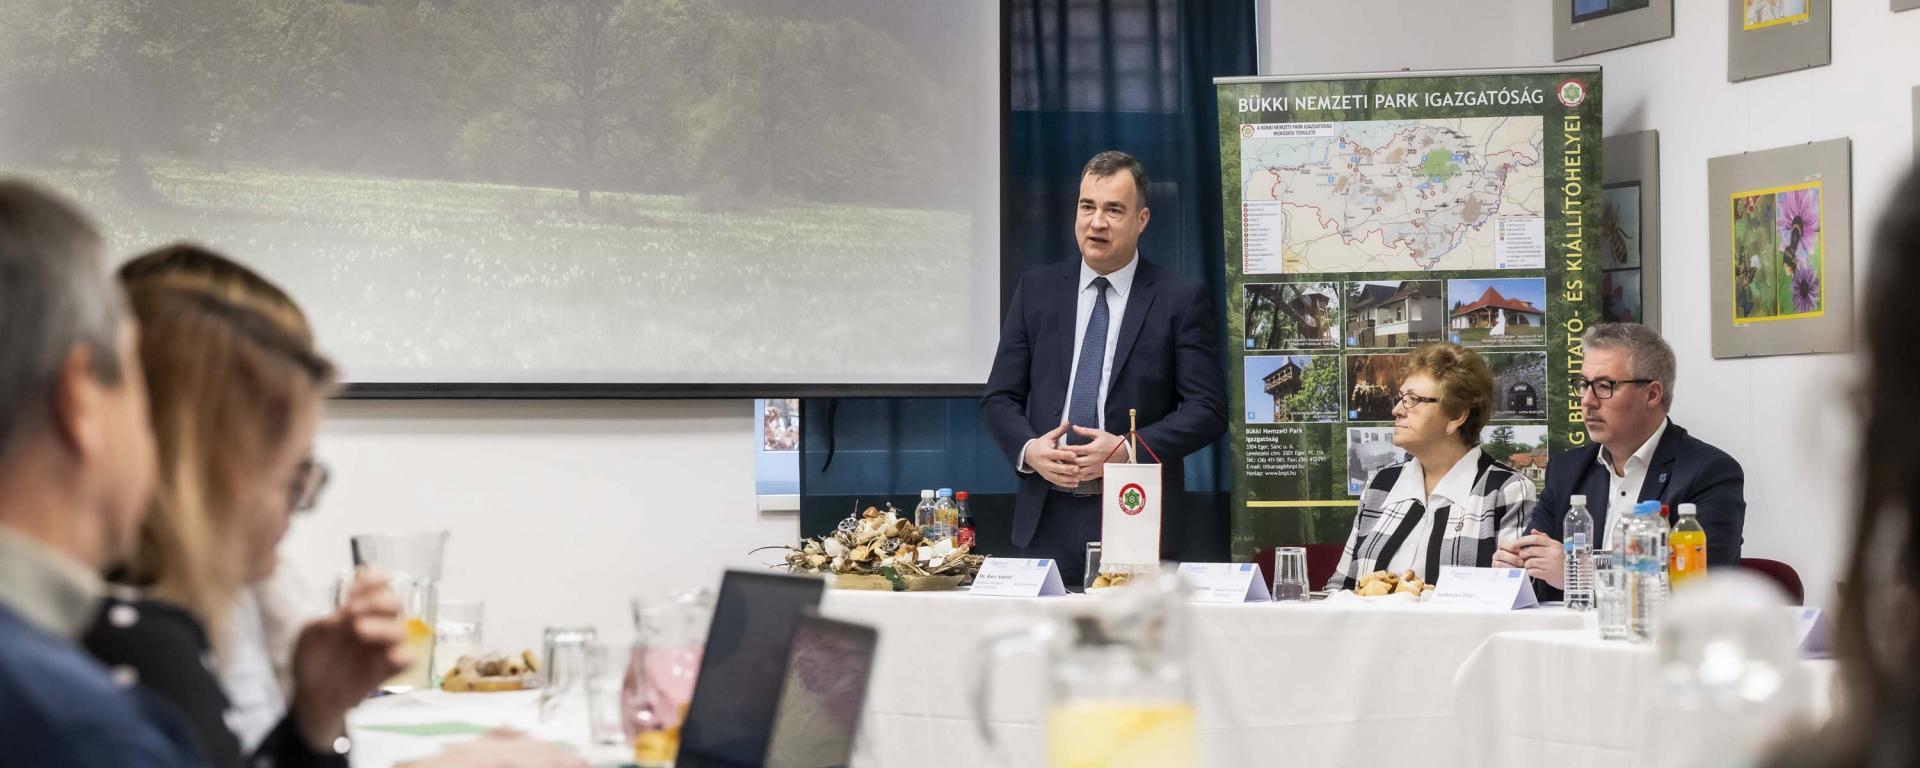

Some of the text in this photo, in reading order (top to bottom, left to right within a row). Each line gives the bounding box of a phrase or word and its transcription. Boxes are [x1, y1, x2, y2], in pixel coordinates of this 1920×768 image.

[1238, 95, 1288, 113] BÜKKI
[1295, 94, 1368, 111] NEMZETI
[1375, 93, 1419, 109] PARK
[1425, 86, 1544, 107] IGAZGATÓSÁG
[1561, 115, 1583, 271] KIÁLLÍTÓHELYEI
[1562, 279, 1584, 302] ÉS
